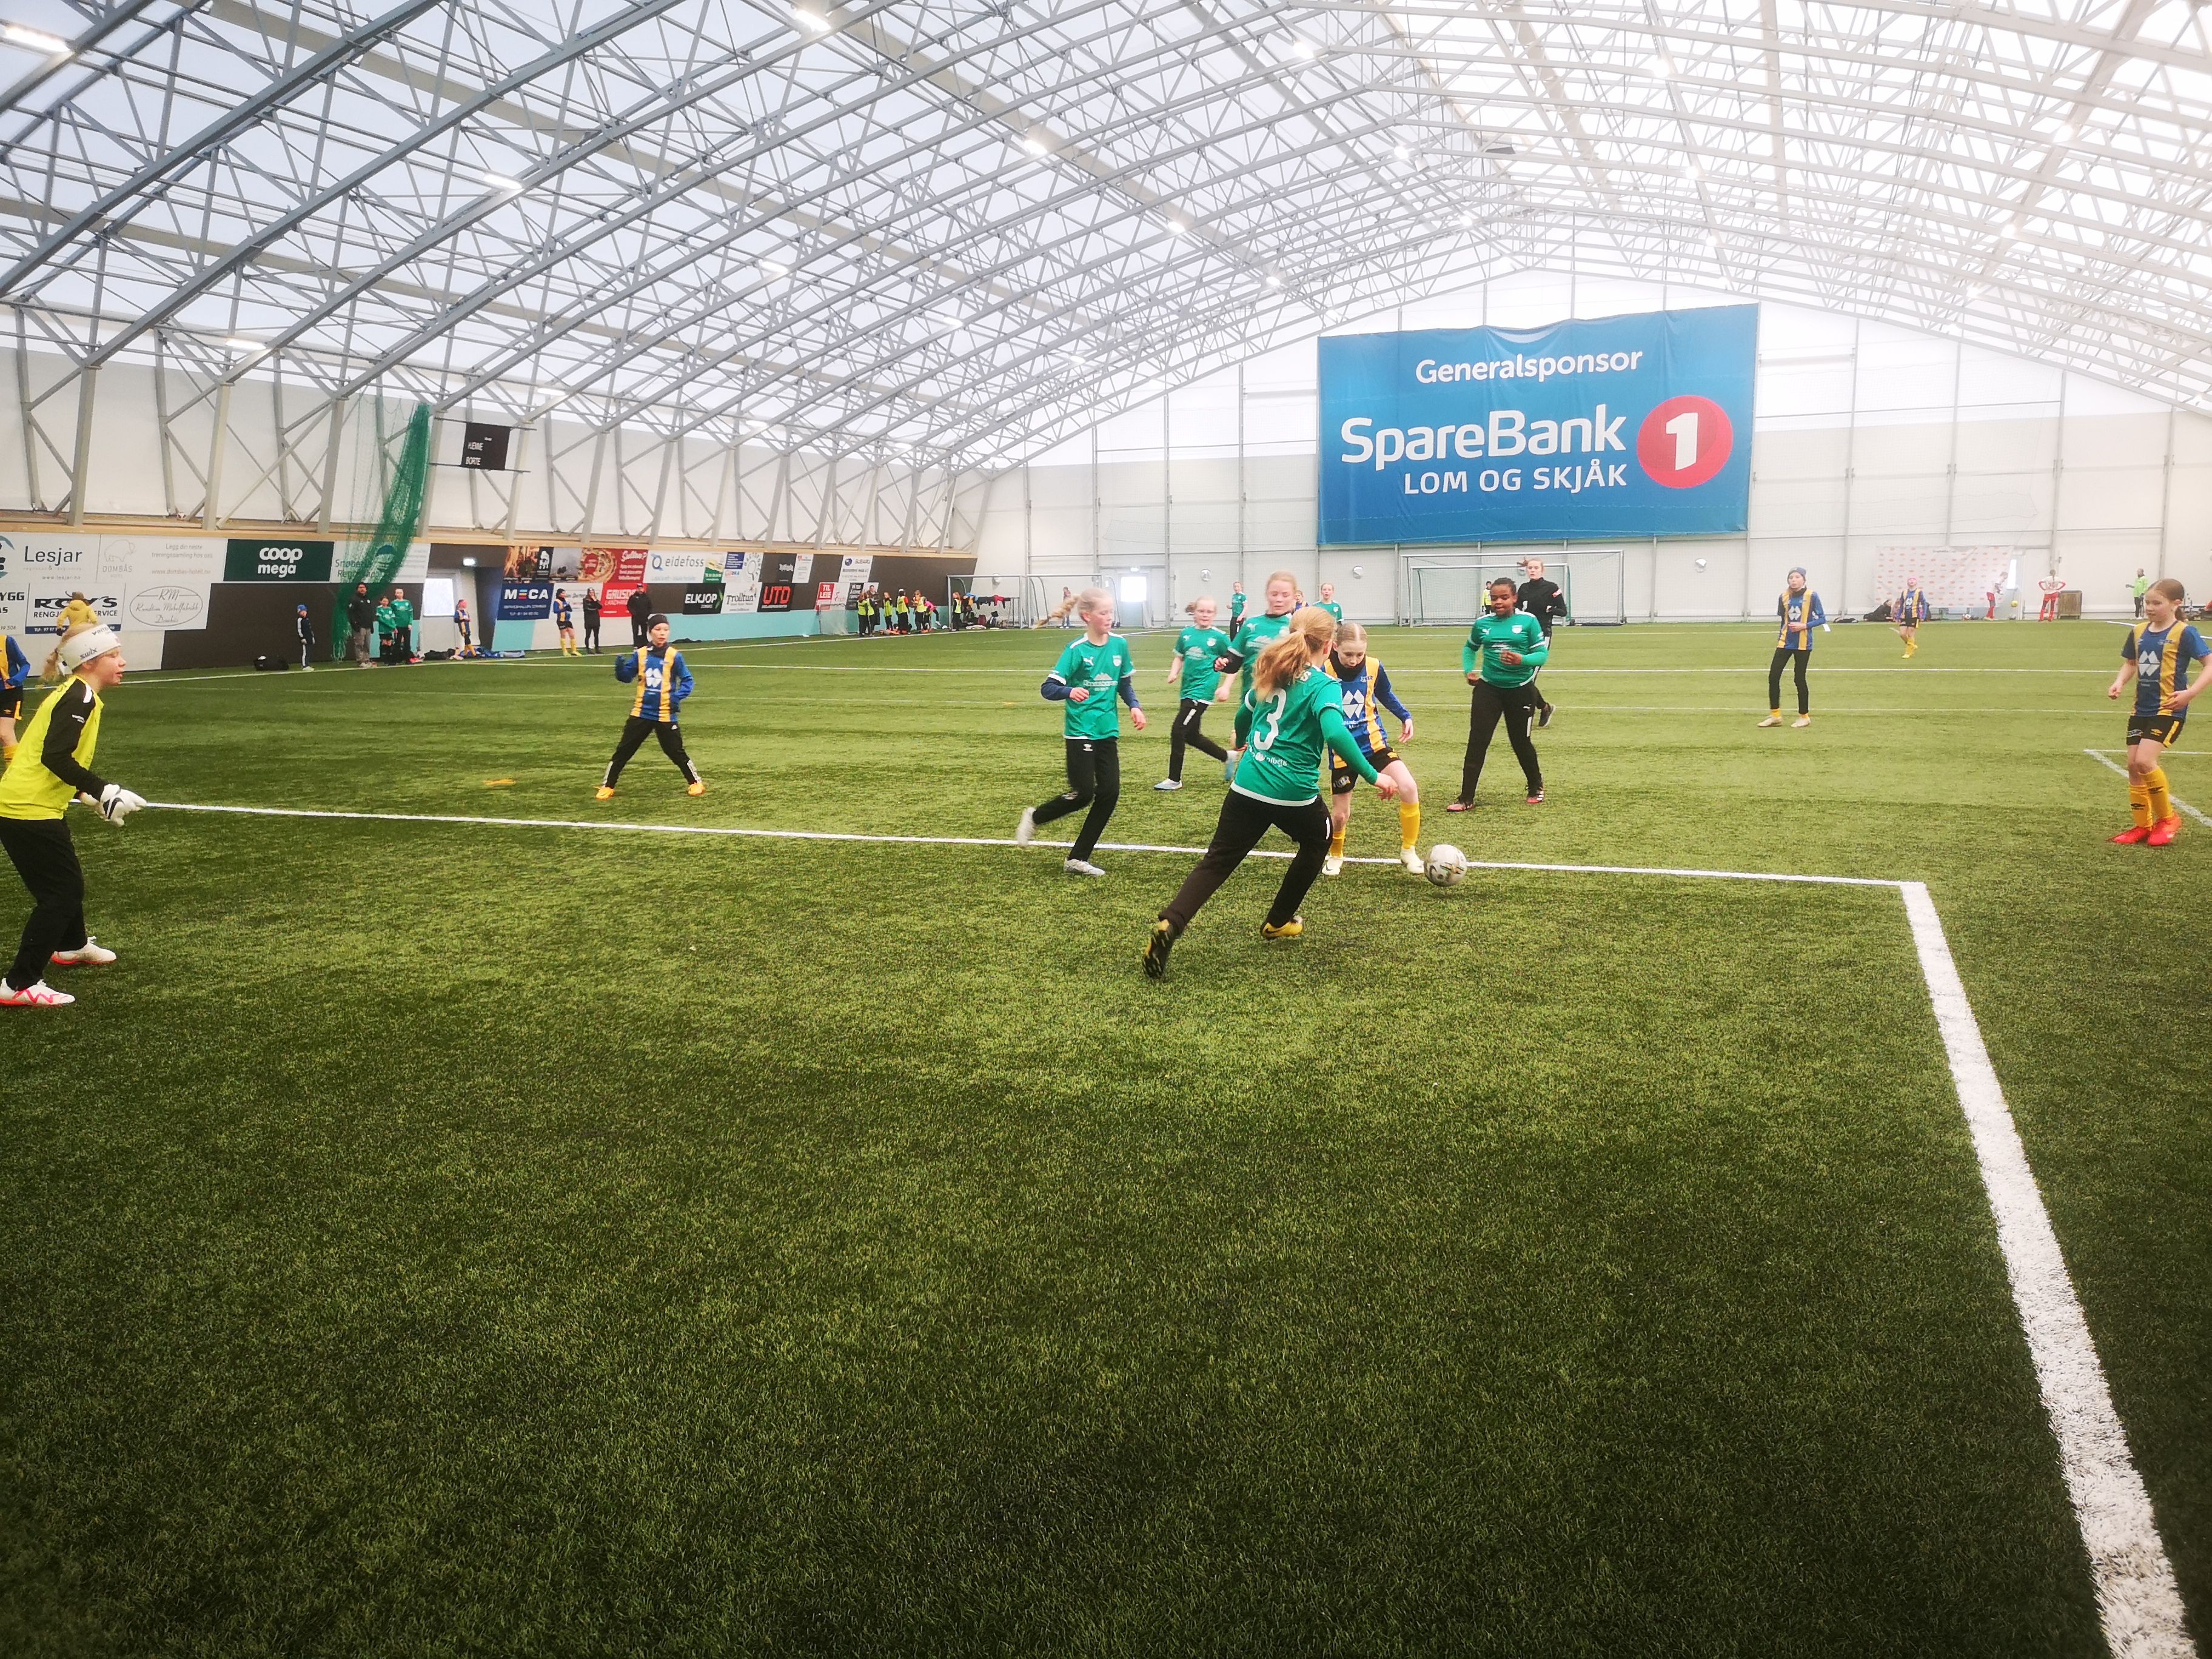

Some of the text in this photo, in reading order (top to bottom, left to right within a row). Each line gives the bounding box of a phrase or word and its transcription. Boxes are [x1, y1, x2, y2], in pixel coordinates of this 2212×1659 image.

[1416, 352, 1643, 384] Generalsponsor
[1341, 404, 1698, 471] SpareBank 1
[1404, 458, 1627, 495] LOM OG SKJÅK
[24, 546, 82, 566] Lesjar
[259, 547, 303, 563] coop
[665, 555, 704, 568] eidefoss
[257, 563, 297, 578] mega
[504, 589, 549, 600] MECA
[1253, 688, 1287, 750] 3
